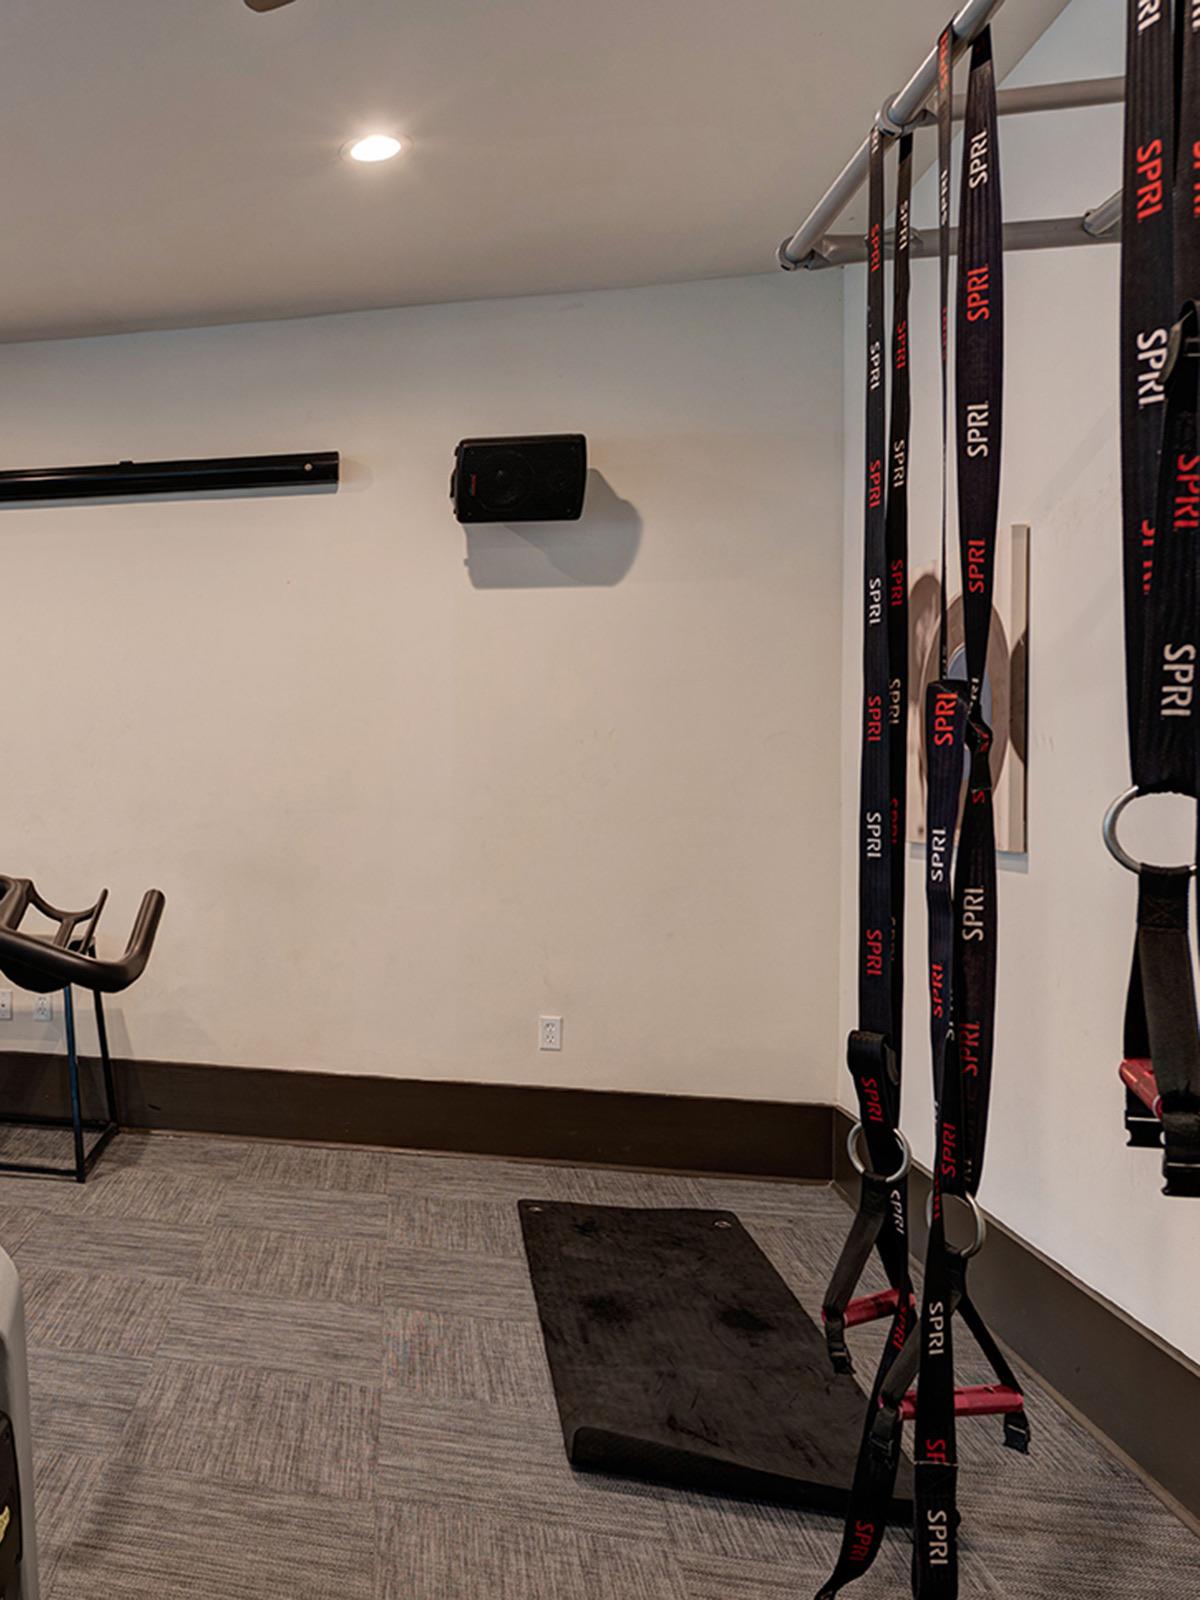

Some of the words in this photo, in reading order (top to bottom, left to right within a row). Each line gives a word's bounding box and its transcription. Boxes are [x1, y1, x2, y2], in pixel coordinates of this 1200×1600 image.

[969, 130, 988, 189] SPRI
[1136, 138, 1163, 220] SPRI
[870, 223, 880, 272] SPRI
[967, 267, 990, 322] SPRI
[870, 341, 881, 390] SPRI
[896, 320, 907, 369] SPRI
[1136, 328, 1168, 405] SPRI
[967, 403, 989, 457] SPRI
[869, 459, 881, 508] SPRI
[893, 439, 905, 487] SPRI
[1173, 453, 1200, 528] SPRI
[890, 560, 903, 607] SPRI
[968, 539, 986, 593] SPRI
[869, 577, 881, 625] SPRI
[889, 678, 901, 724] SPRI
[1160, 643, 1197, 717] SPRI
[867, 695, 881, 741] SPRI
[933, 692, 958, 746] SPRI
[866, 812, 882, 858] SPRI
[931, 828, 947, 882] SPRI
[962, 887, 984, 941] SPRI
[866, 929, 883, 976] SPRI
[931, 963, 944, 1018] SPRI
[960, 1022, 981, 1077] SPRI
[860, 1076, 883, 1123] SPRI
[941, 1122, 956, 1177] SPRI
[929, 1301, 944, 1355] SPRI
[848, 1520, 875, 1561] SPRI
[927, 1510, 948, 1564] SPRI
